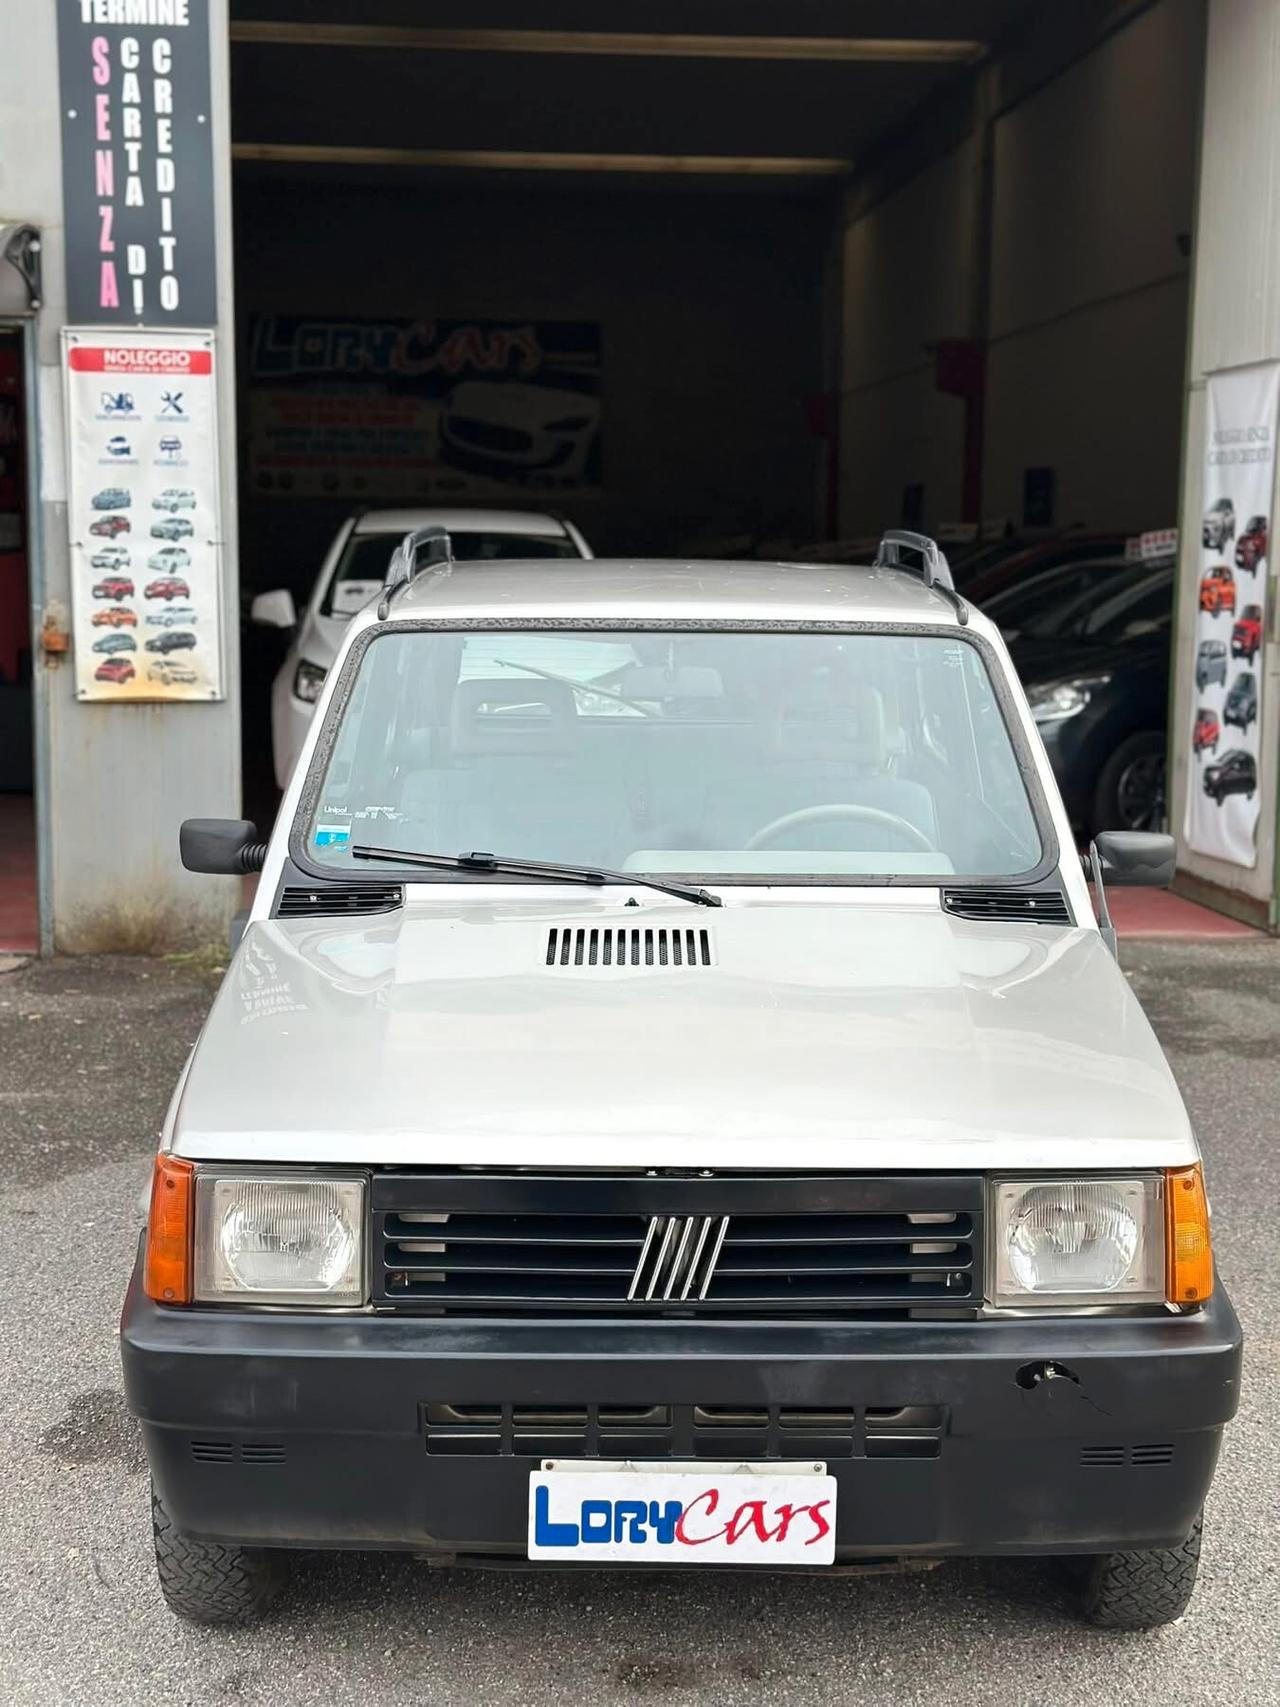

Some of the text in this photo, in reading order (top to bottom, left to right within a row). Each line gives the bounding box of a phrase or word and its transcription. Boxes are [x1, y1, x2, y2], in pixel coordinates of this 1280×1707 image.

[80, 0, 190, 26] TERMINE
[91, 35, 120, 309] SENZA
[120, 36, 144, 207] CARTA
[152, 38, 179, 311] CREDITO
[103, 349, 191, 366] NOLEGGIO
